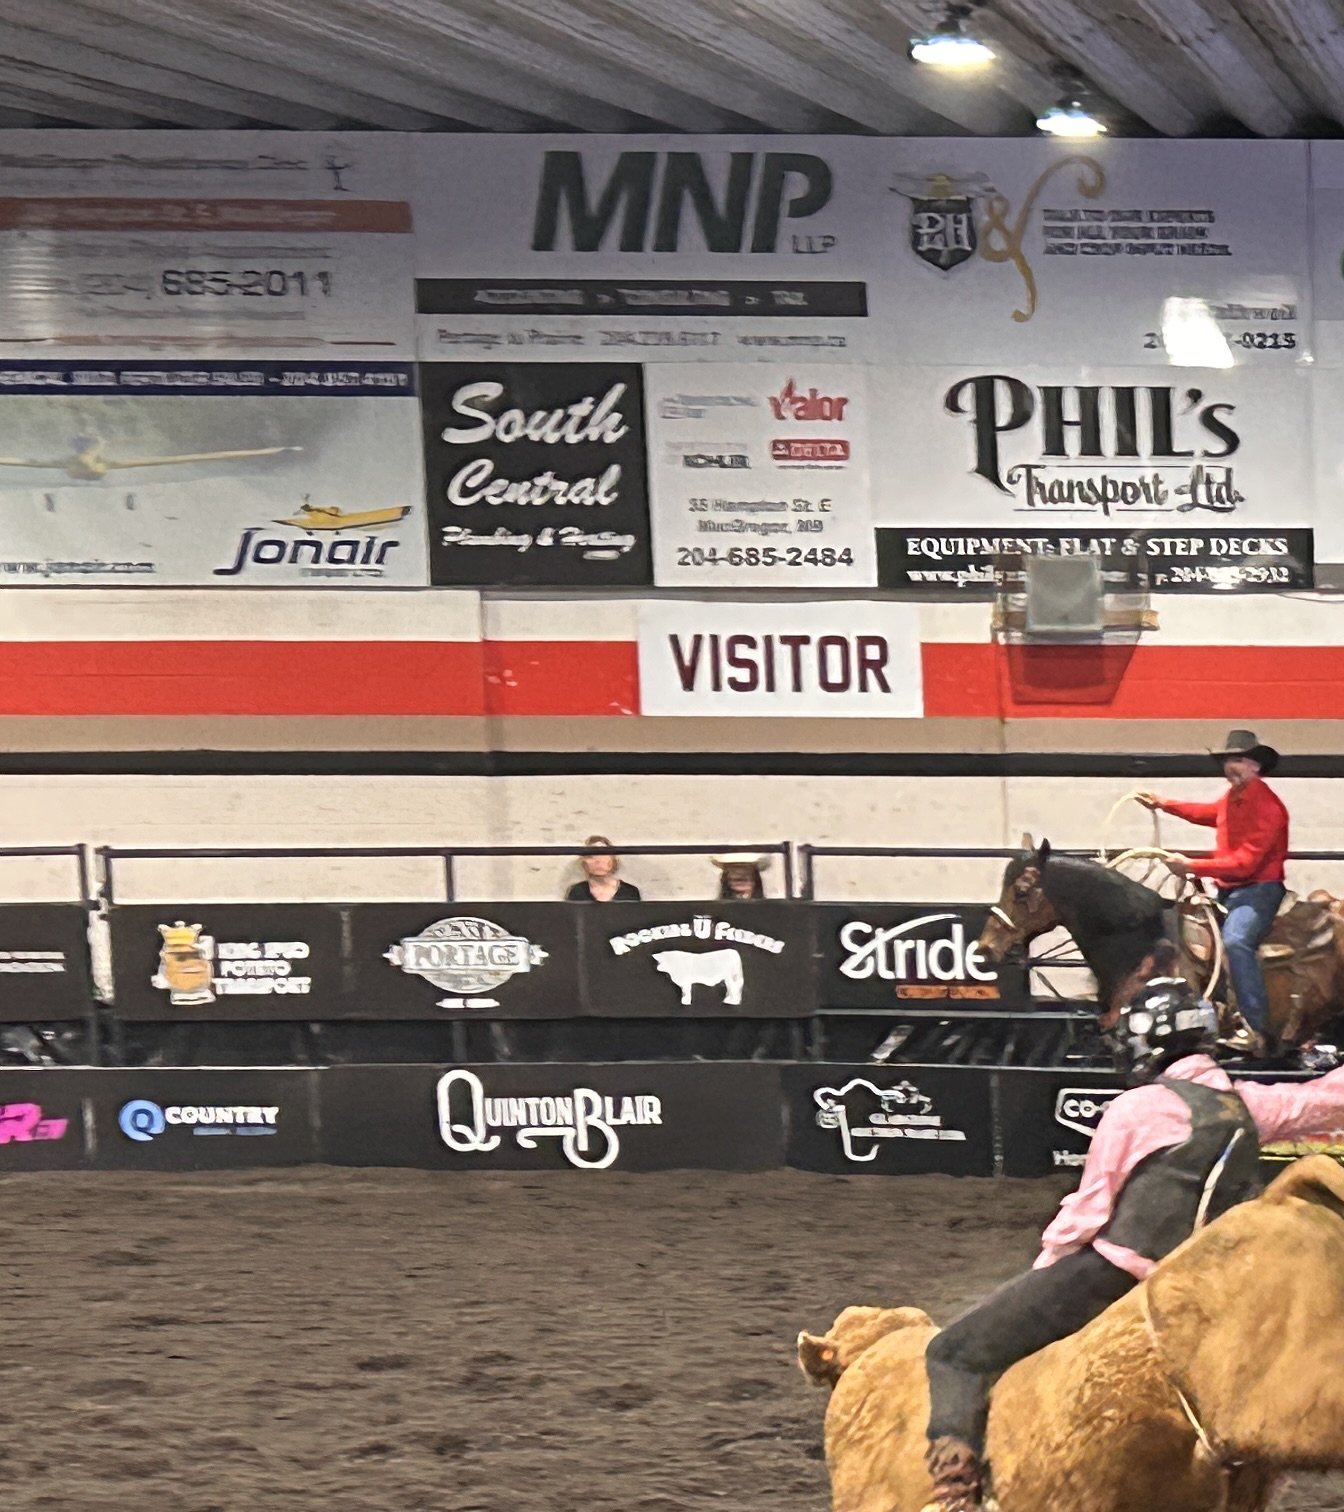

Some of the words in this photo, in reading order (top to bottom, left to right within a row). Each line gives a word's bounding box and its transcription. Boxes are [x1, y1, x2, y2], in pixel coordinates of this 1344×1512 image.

[532, 151, 834, 253] MNP
[442, 381, 630, 445] South
[446, 458, 621, 507] Central
[1003, 463, 1170, 516] Transport
[213, 527, 400, 576] Jonair
[1059, 537, 1116, 557] FLAT
[1121, 537, 1141, 557] &
[1146, 537, 1204, 556] STEP
[1209, 537, 1289, 556] DECKS
[670, 632, 891, 696] VISITOR
[413, 943, 521, 968] PORTAGE
[838, 913, 999, 982] Stride
[164, 1106, 280, 1125] COUNTRY
